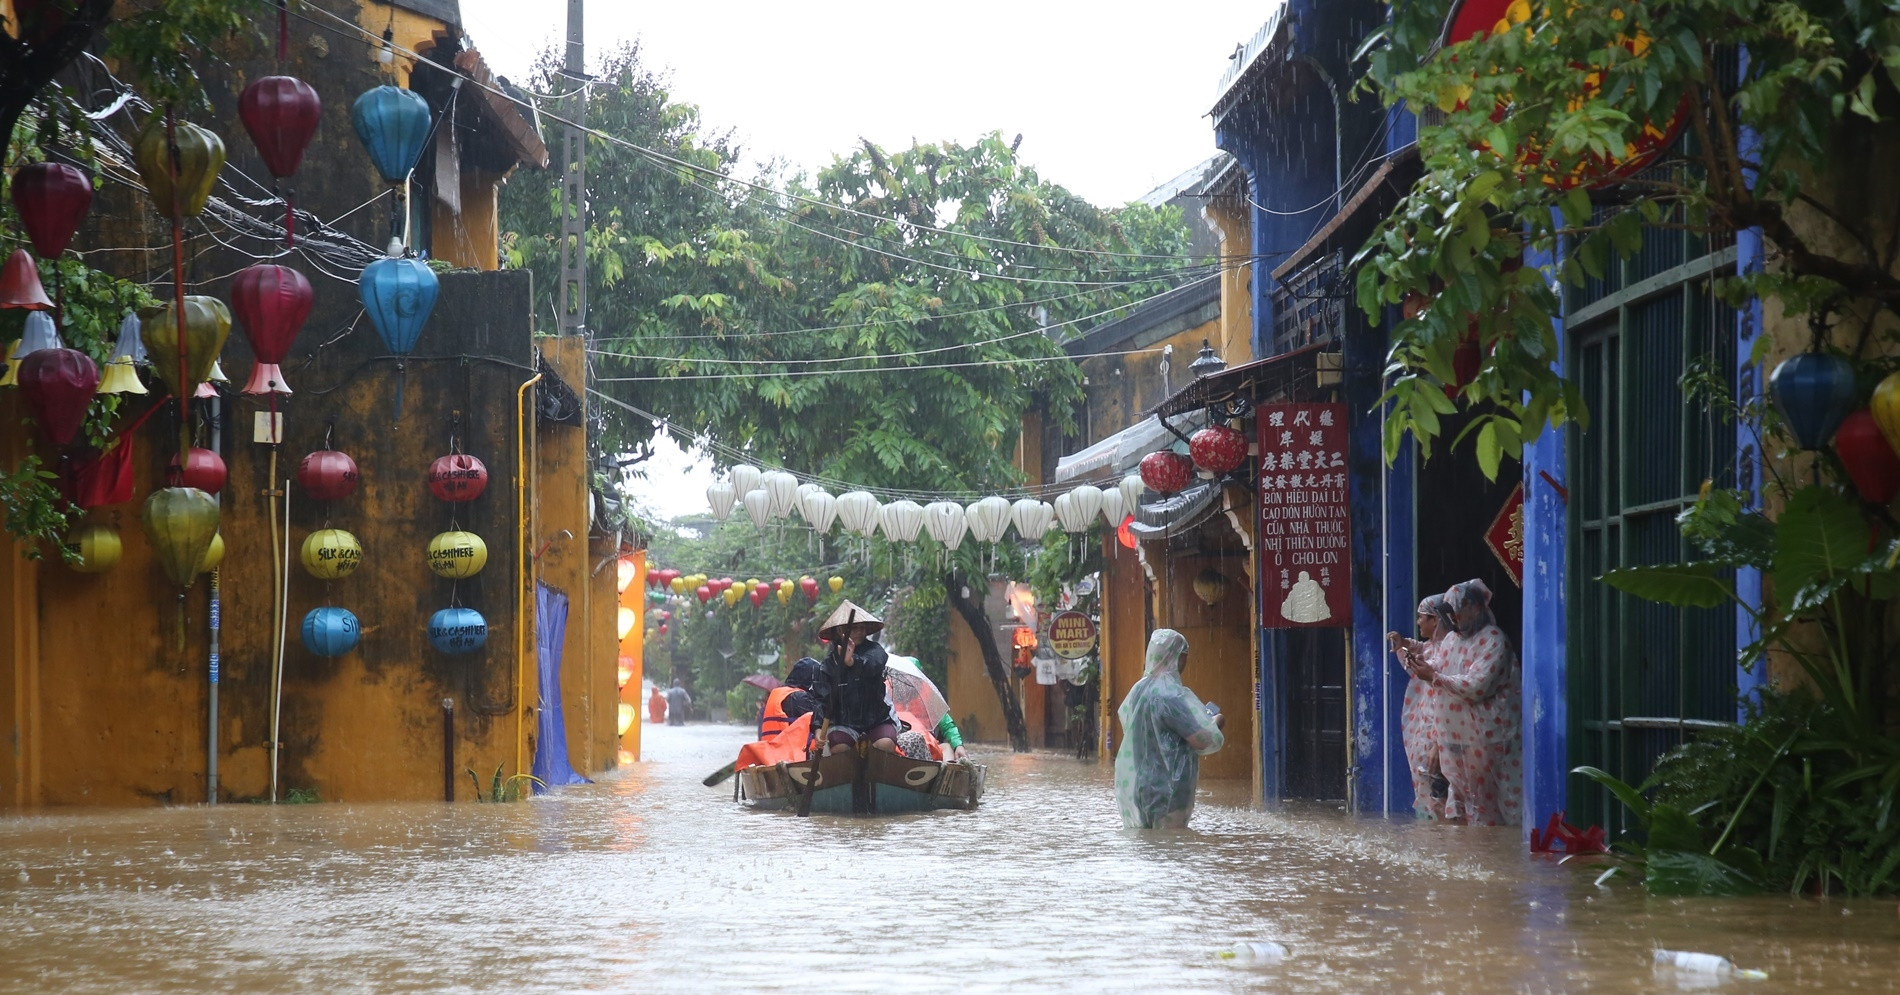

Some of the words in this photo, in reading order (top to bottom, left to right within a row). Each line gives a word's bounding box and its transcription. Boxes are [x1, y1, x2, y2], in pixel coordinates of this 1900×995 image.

[1262, 507, 1281, 520] CAO
[1058, 617, 1086, 629] MINI
[1056, 628, 1089, 639] MART
